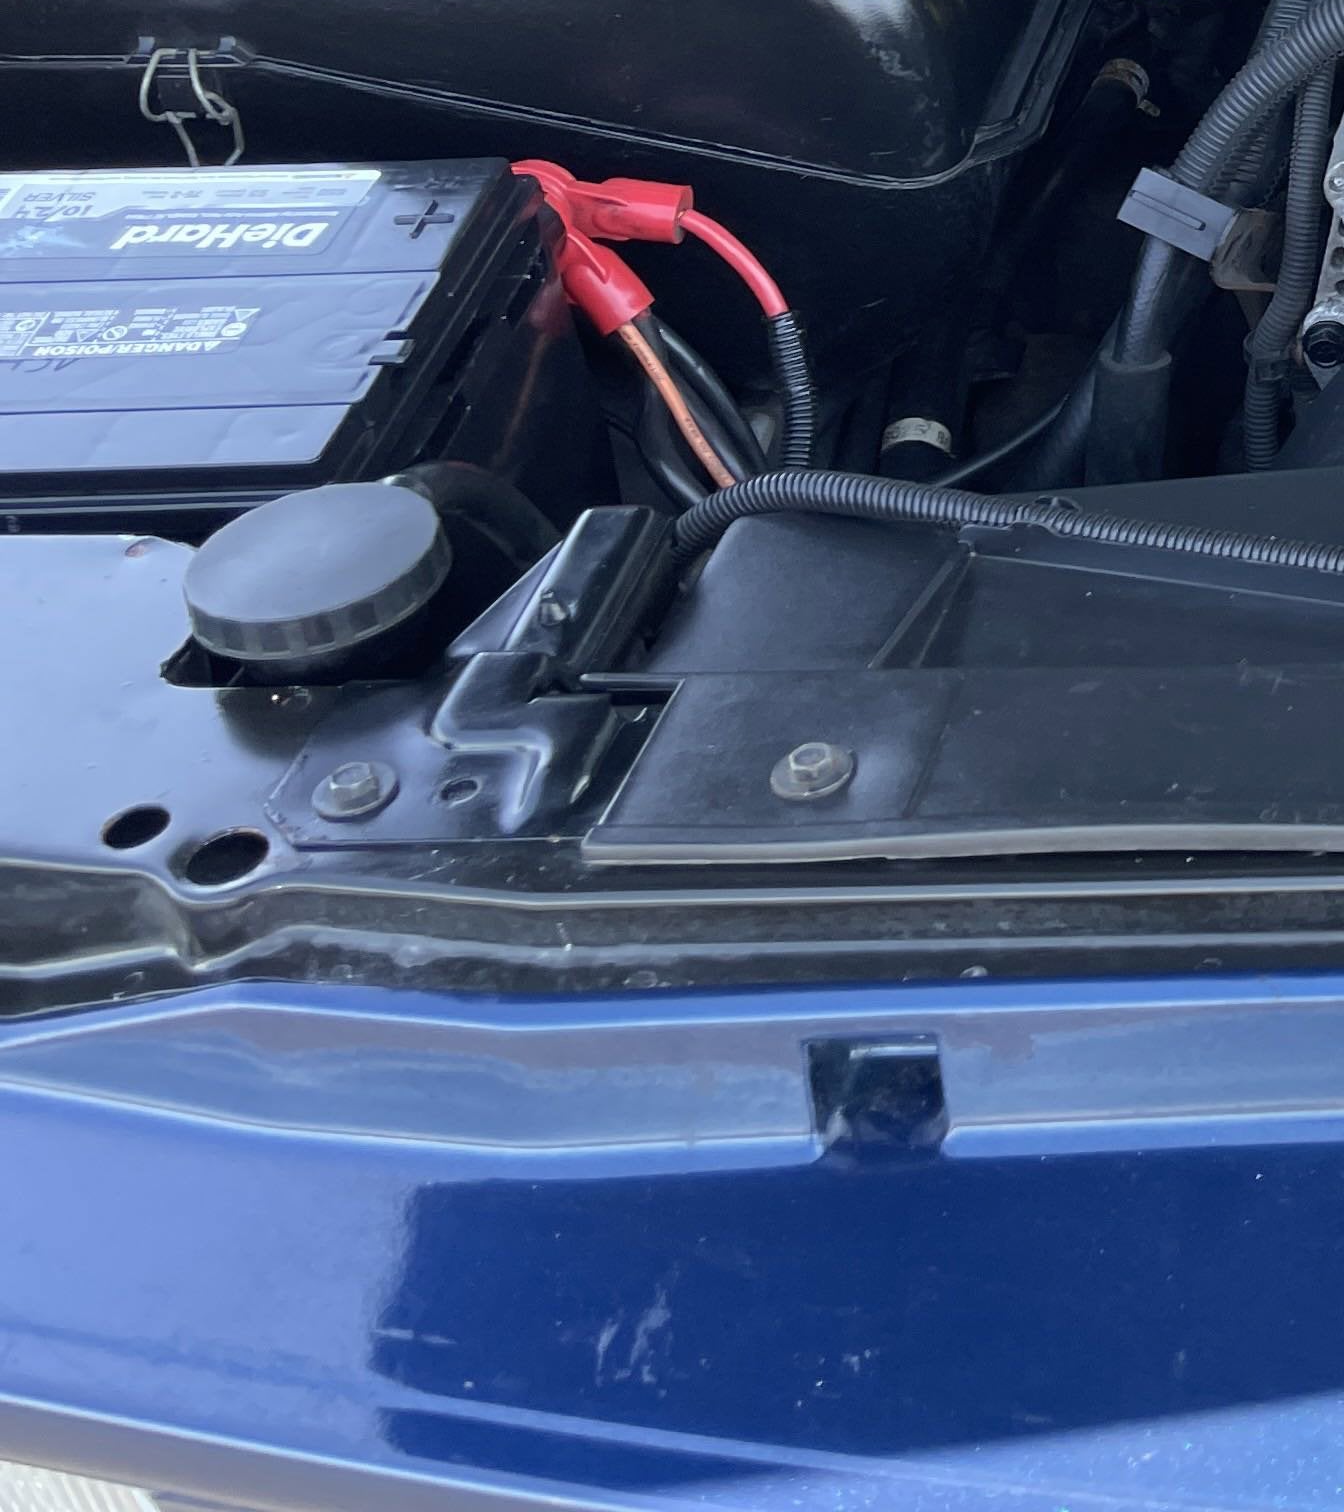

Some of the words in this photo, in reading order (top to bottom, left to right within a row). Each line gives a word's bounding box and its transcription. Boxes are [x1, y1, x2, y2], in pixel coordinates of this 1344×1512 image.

[23, 190, 96, 203] SILVER
[15, 204, 94, 221] 10/24
[109, 221, 330, 250] DieHard
[33, 340, 206, 357] DANGER/POISON
